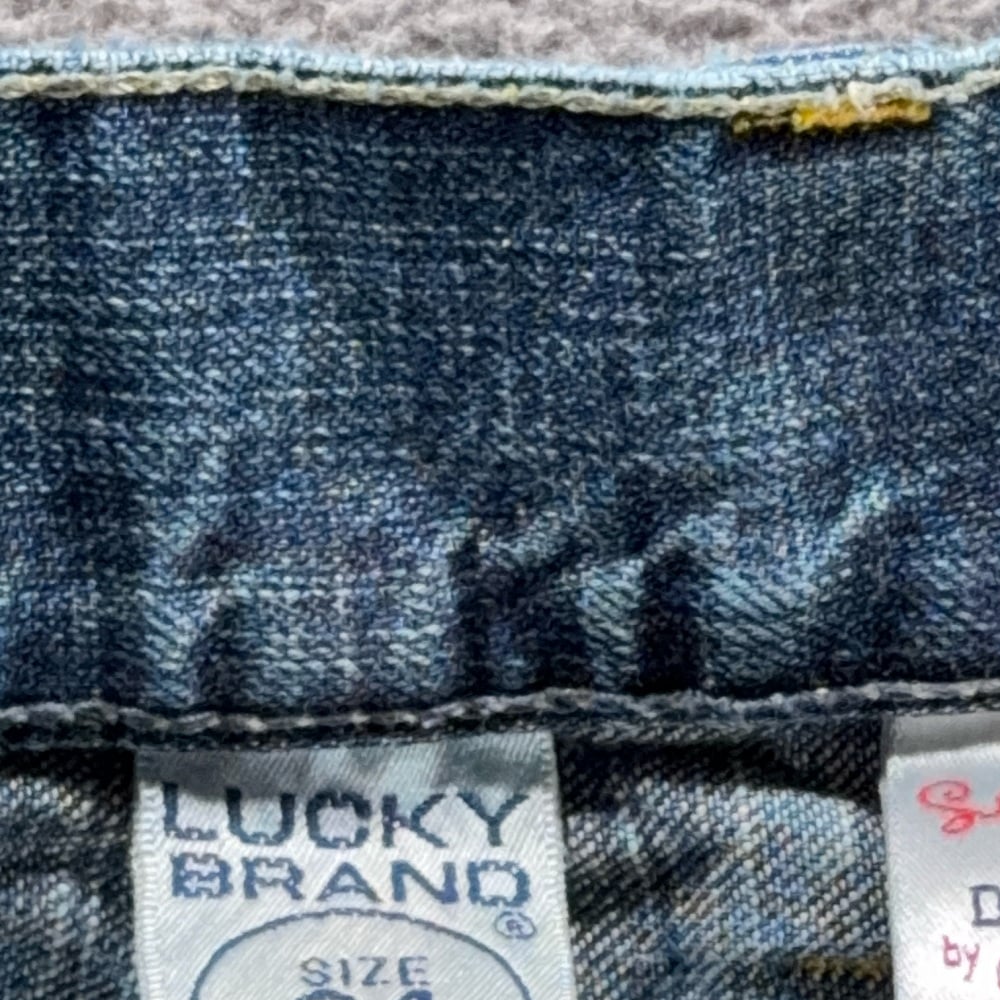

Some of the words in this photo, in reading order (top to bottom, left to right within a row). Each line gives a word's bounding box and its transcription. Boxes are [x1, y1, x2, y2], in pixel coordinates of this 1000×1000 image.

[161, 780, 530, 850] LUCKY
[170, 852, 532, 908] BRAND
[300, 955, 433, 988] SIZE
[942, 934, 981, 982] by
